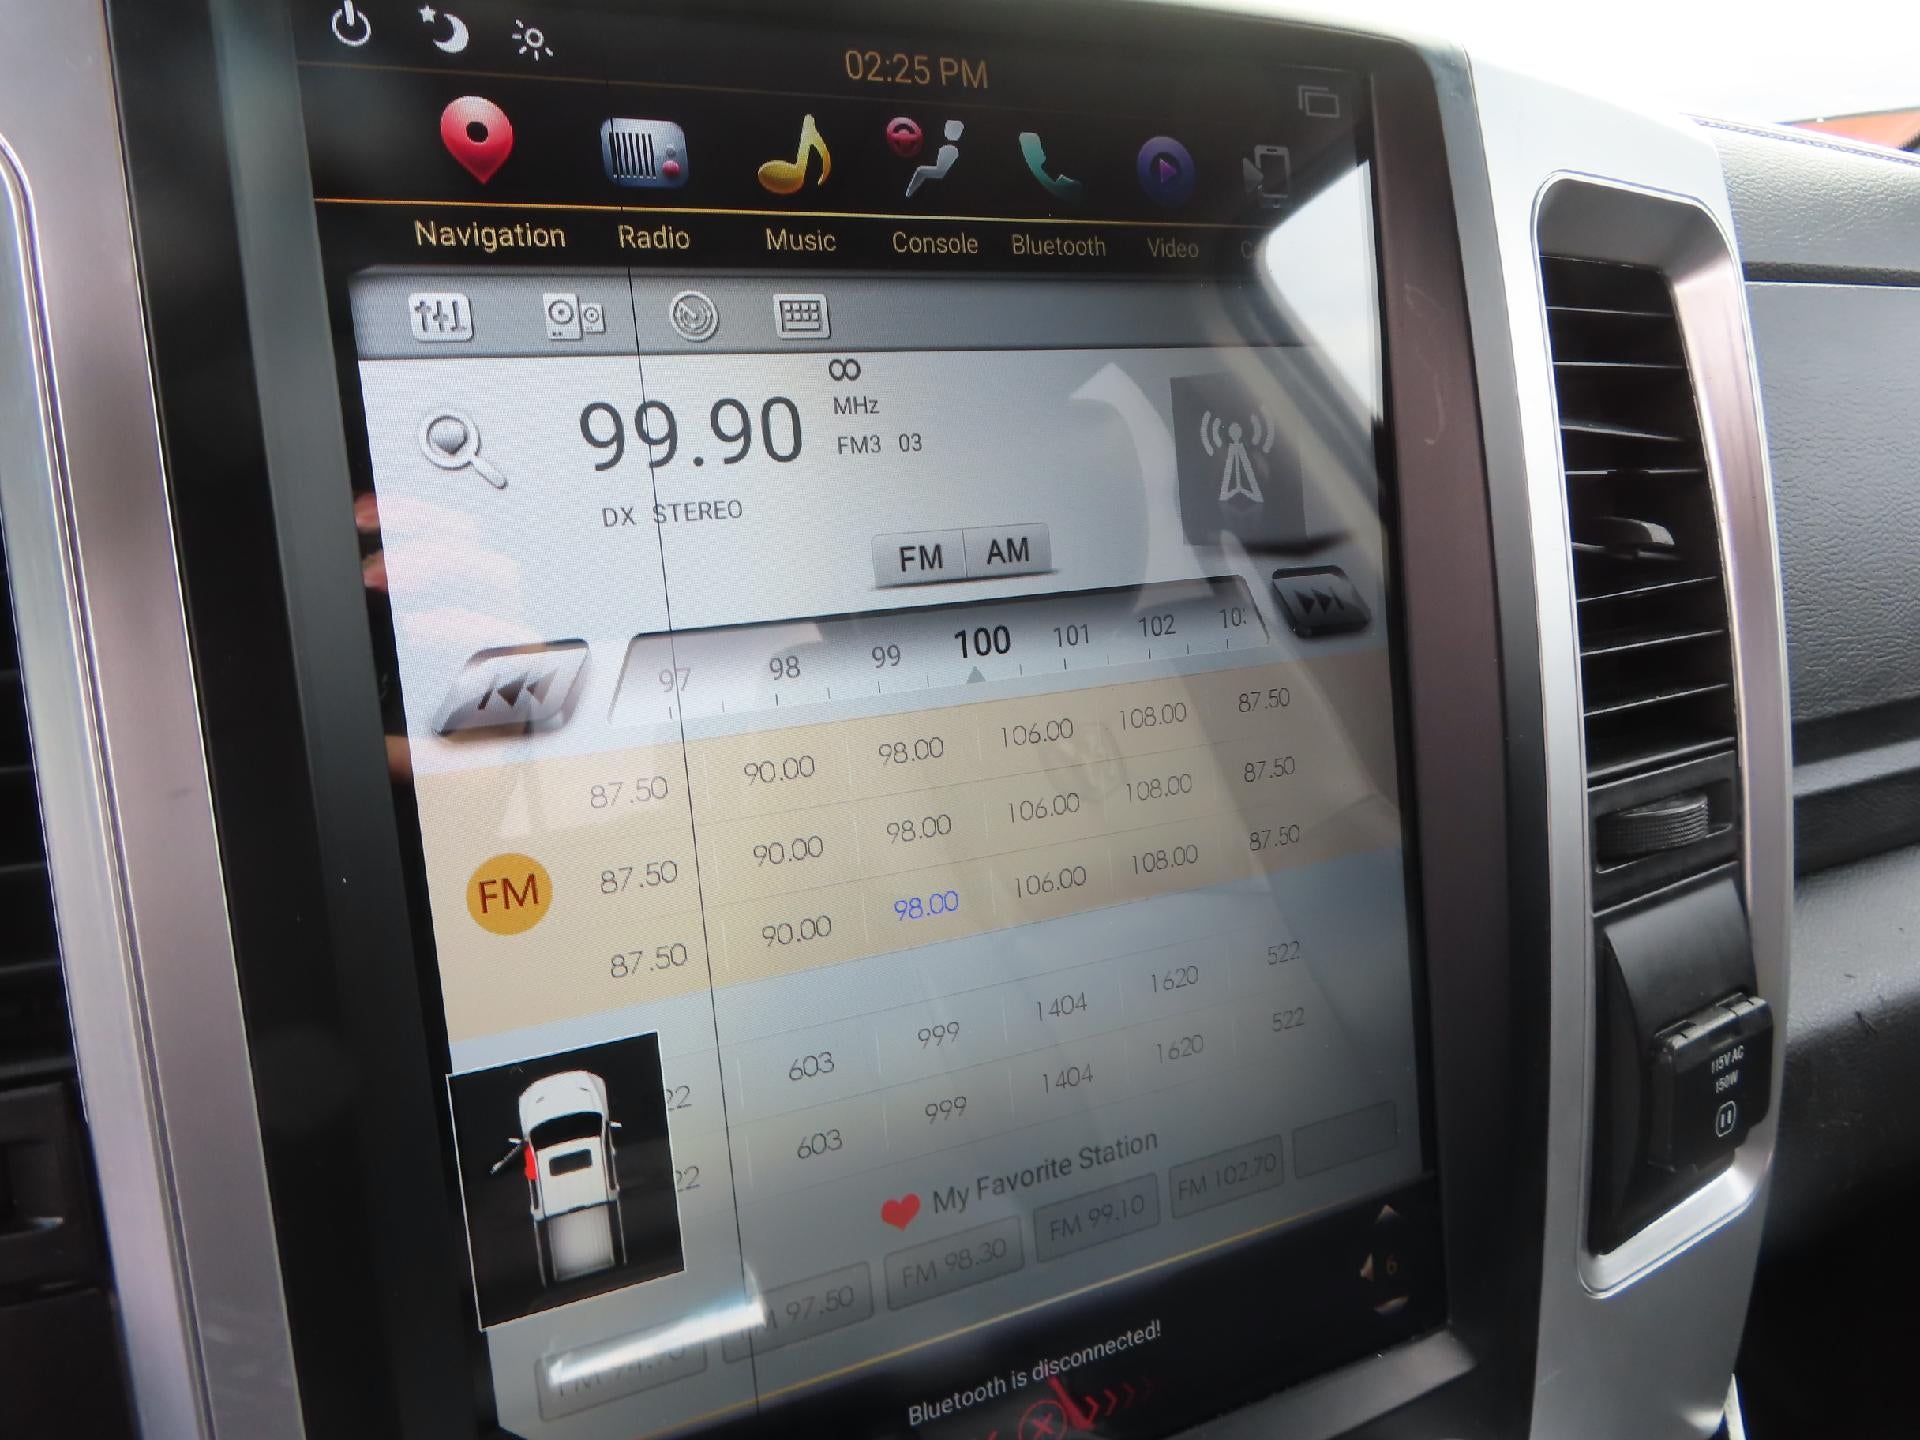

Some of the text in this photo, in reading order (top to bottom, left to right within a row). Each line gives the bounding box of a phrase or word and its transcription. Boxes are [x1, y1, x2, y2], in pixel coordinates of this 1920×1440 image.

[844, 49, 989, 90] 02:25 PM
[414, 219, 567, 253] Navigation
[617, 224, 691, 251] Radio
[765, 227, 837, 253] Music
[891, 231, 979, 256] Console
[1011, 233, 1107, 258] Bluetooth
[1146, 237, 1199, 259] Video
[832, 396, 880, 416] MHz
[579, 396, 802, 472] 99.90
[837, 434, 923, 456] FM3 03
[602, 500, 744, 527] DX STEREO
[899, 544, 944, 572] FM
[986, 538, 1031, 565] AM
[658, 667, 692, 694] 97
[769, 655, 802, 681] 98
[871, 644, 902, 669] 99
[954, 624, 1012, 660] 100
[1053, 623, 1091, 649] 101
[1138, 614, 1177, 637] 102
[590, 687, 1292, 810] 87.50 90.00 98.00 106.00 108.00 87.50
[600, 756, 1296, 894] 87.50 90.00 98.00 106.00 108.00 87.50
[478, 872, 540, 914] FM
[610, 824, 1301, 979] 87.50 90.00 98.00 106.00 108.00 87.50
[788, 1051, 836, 1081] 603
[917, 1021, 961, 1050] 999
[1036, 992, 1088, 1022] 1404
[1150, 965, 1199, 993] 1620
[1267, 940, 1301, 966] 522
[1711, 1051, 1732, 1075] 115V
[1715, 1069, 1739, 1094] 150W
[797, 1128, 843, 1160] 603
[925, 1096, 968, 1125] 999
[1042, 1063, 1094, 1094] 1404
[1156, 1034, 1204, 1064] 1620
[1272, 1007, 1305, 1033] 522
[932, 1130, 1159, 1216] My Favorite Station
[1177, 1152, 1277, 1201] FM 102.70
[1049, 1194, 1146, 1243] FM 99.10
[901, 1237, 1008, 1290] FM 98.30
[785, 1284, 856, 1324] 97.50
[908, 1319, 1163, 1427] Bluetooth is disconnected!
